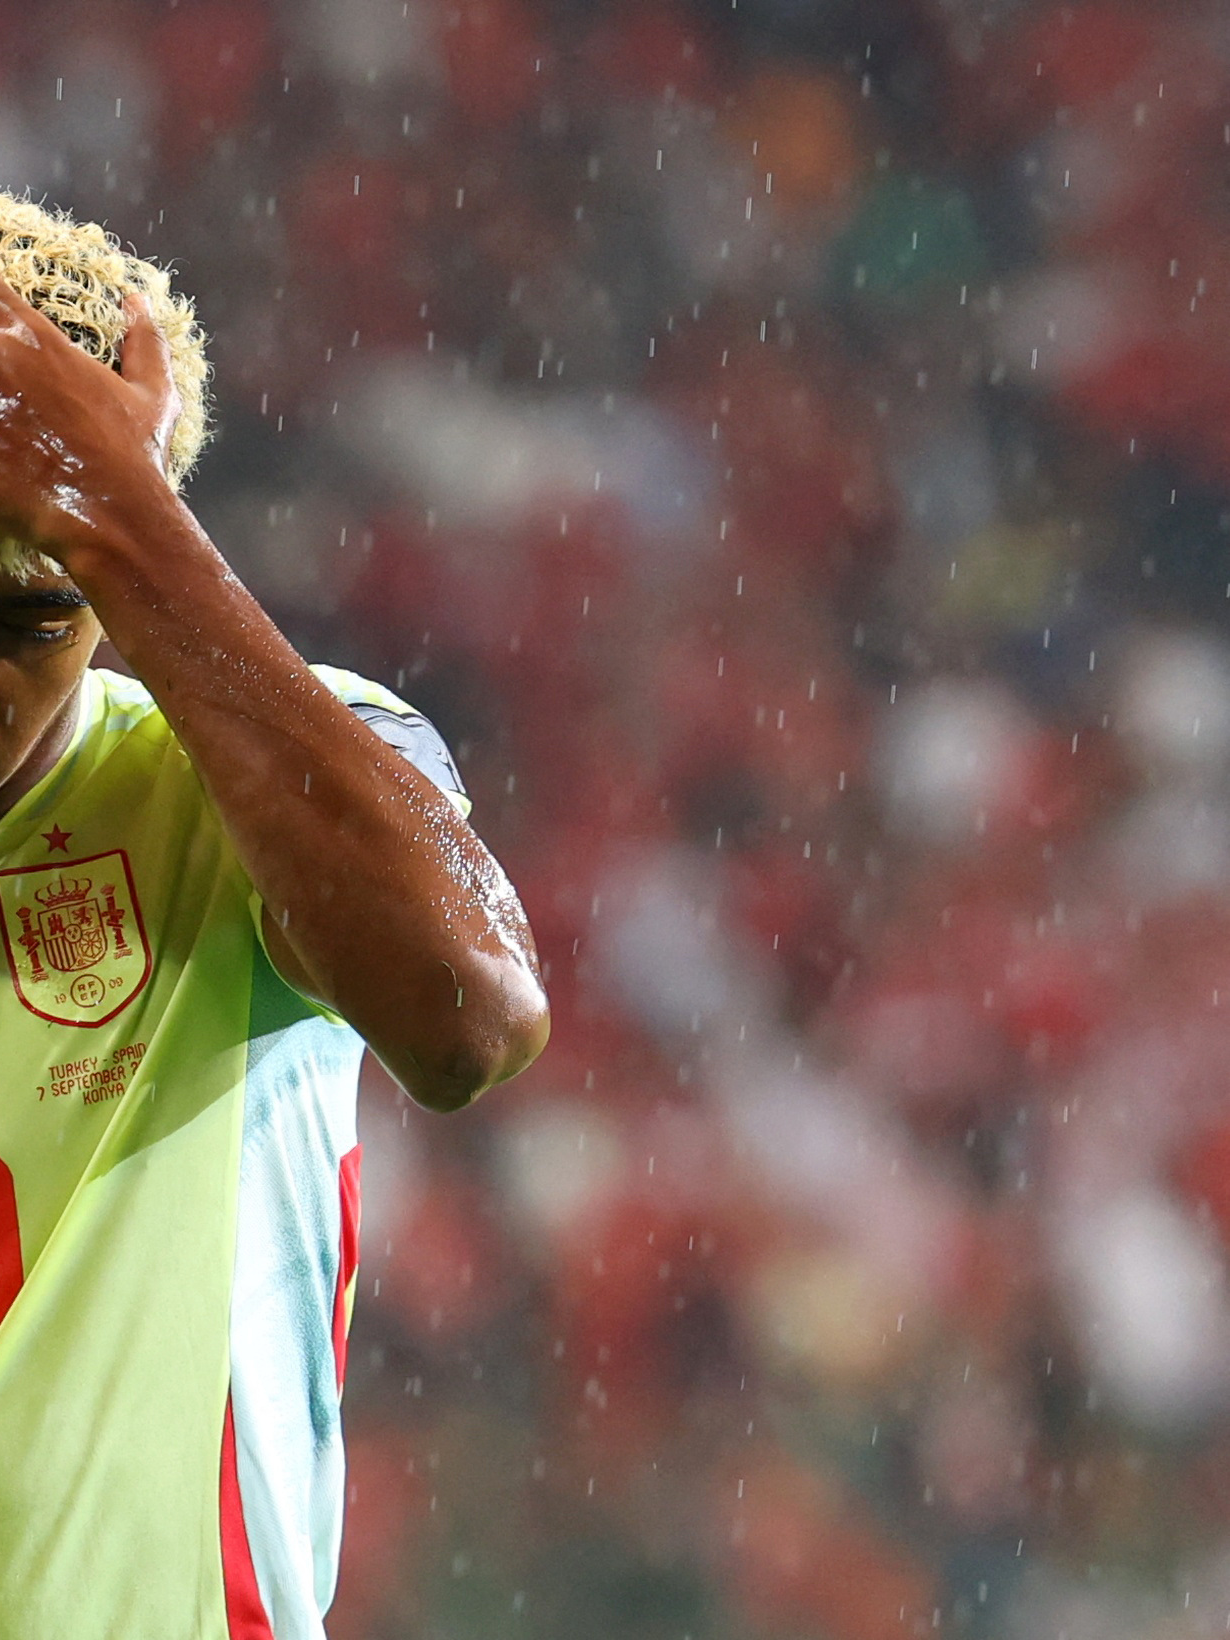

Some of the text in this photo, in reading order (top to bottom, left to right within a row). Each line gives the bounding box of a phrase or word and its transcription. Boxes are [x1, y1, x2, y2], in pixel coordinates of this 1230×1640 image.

[48, 1057, 98, 1081] TURKEY
[112, 1042, 147, 1064] SPAIN
[36, 1086, 45, 1101] 7
[50, 1065, 126, 1097] SEPTEMBER
[82, 1082, 125, 1105] KONYA
